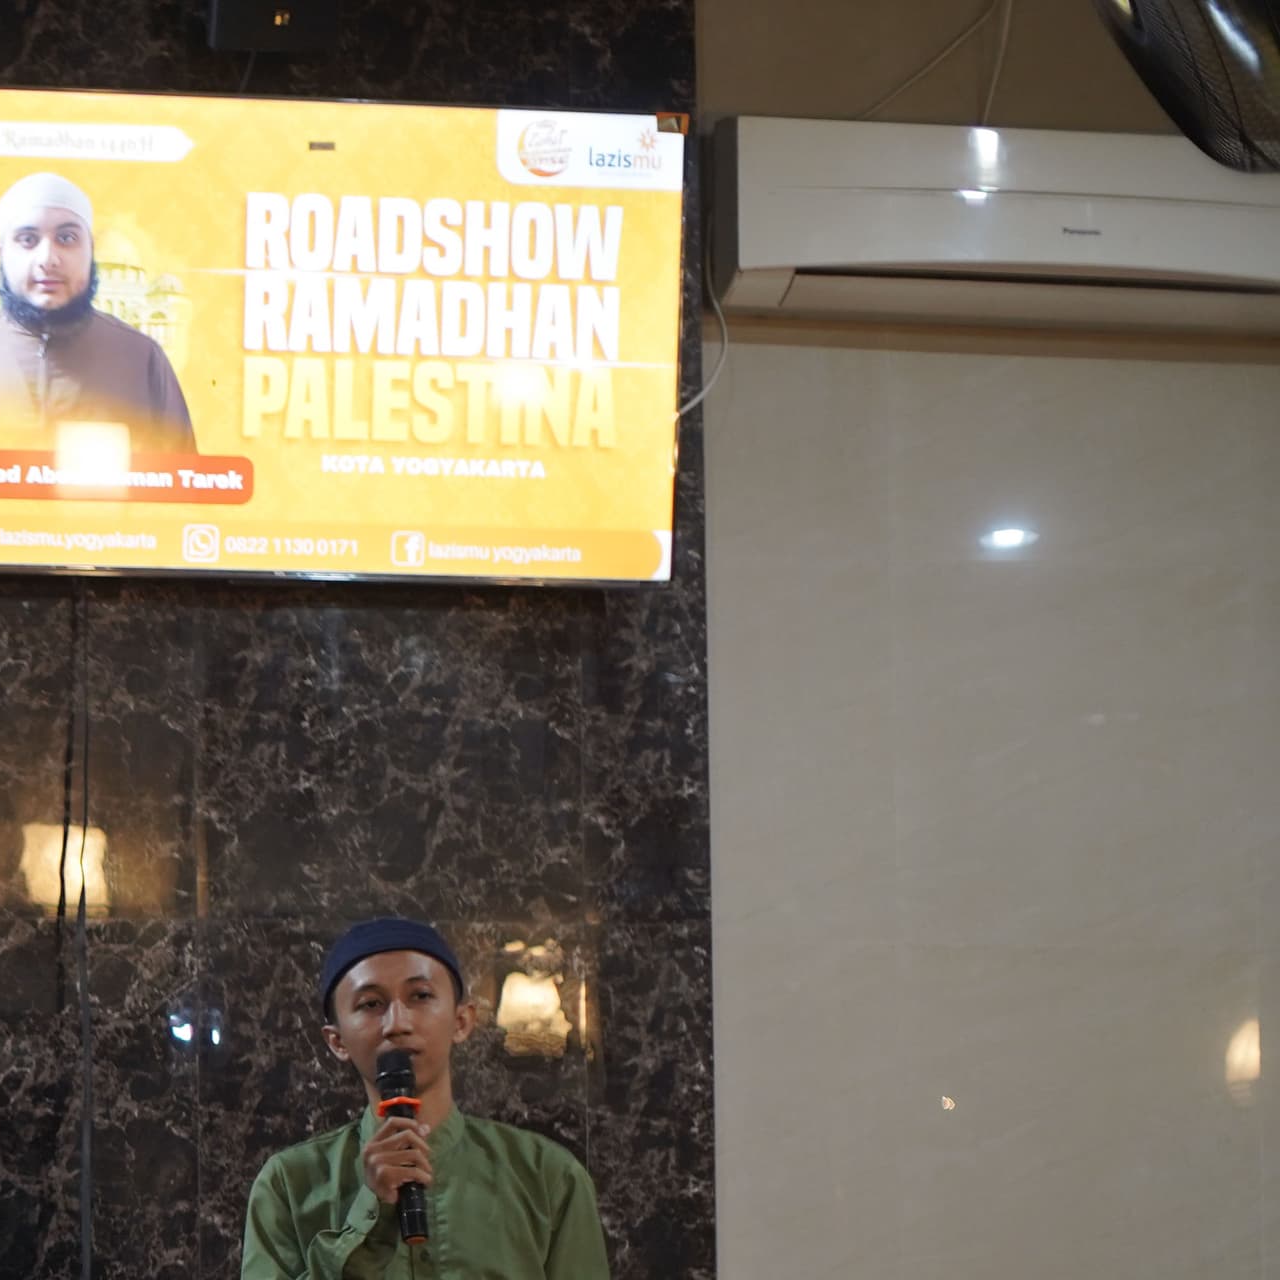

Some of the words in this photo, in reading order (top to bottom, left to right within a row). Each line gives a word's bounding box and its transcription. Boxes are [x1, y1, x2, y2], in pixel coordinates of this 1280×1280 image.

[588, 146, 662, 170] lazismu
[245, 191, 624, 282] ROADSHOW
[243, 270, 621, 362] RAMADHAN
[241, 355, 619, 449] PALESTINA
[321, 454, 385, 475] KOTA
[391, 456, 546, 479] YOGYAKARTA
[177, 468, 244, 490] Tarek
[316, 538, 360, 557] 0171
[491, 544, 582, 564] yogyakarta
